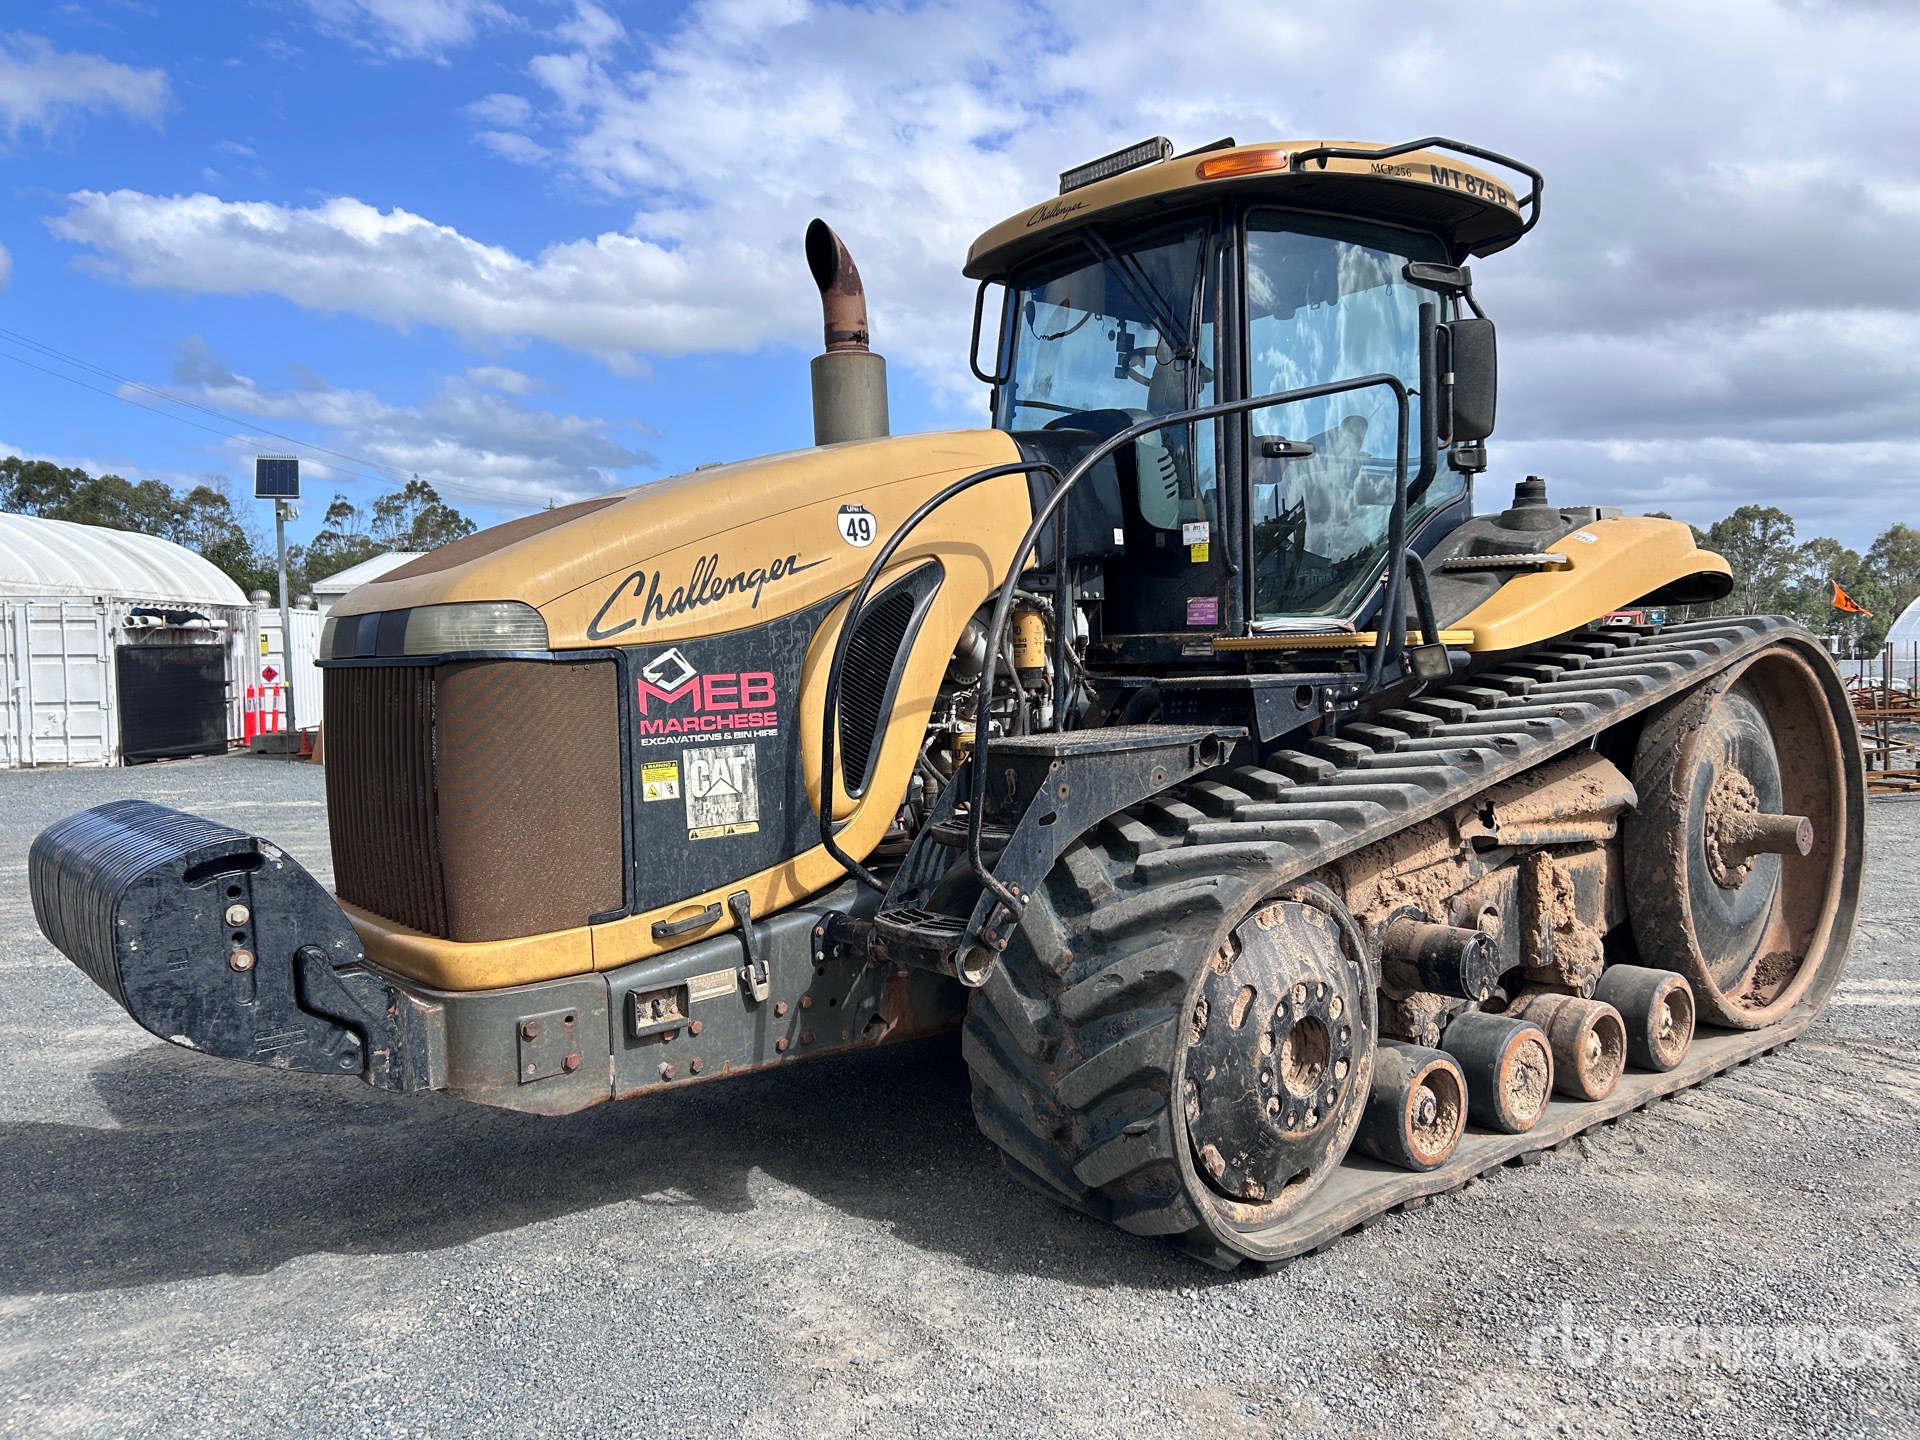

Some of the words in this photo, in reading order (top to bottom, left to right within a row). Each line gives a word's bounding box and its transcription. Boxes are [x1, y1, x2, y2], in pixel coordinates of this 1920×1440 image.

[1026, 199, 1091, 228] Challenger
[846, 517, 871, 542] 49
[586, 553, 832, 642] Challenger
[637, 671, 777, 716] MEB
[639, 711, 778, 735] MARCHESE
[641, 732, 722, 746] EXCAVATIONS
[724, 732, 732, 740] &
[733, 730, 752, 740] BIN
[753, 728, 778, 739] HIRE
[690, 756, 746, 798] CAT
[703, 801, 740, 815] Power
